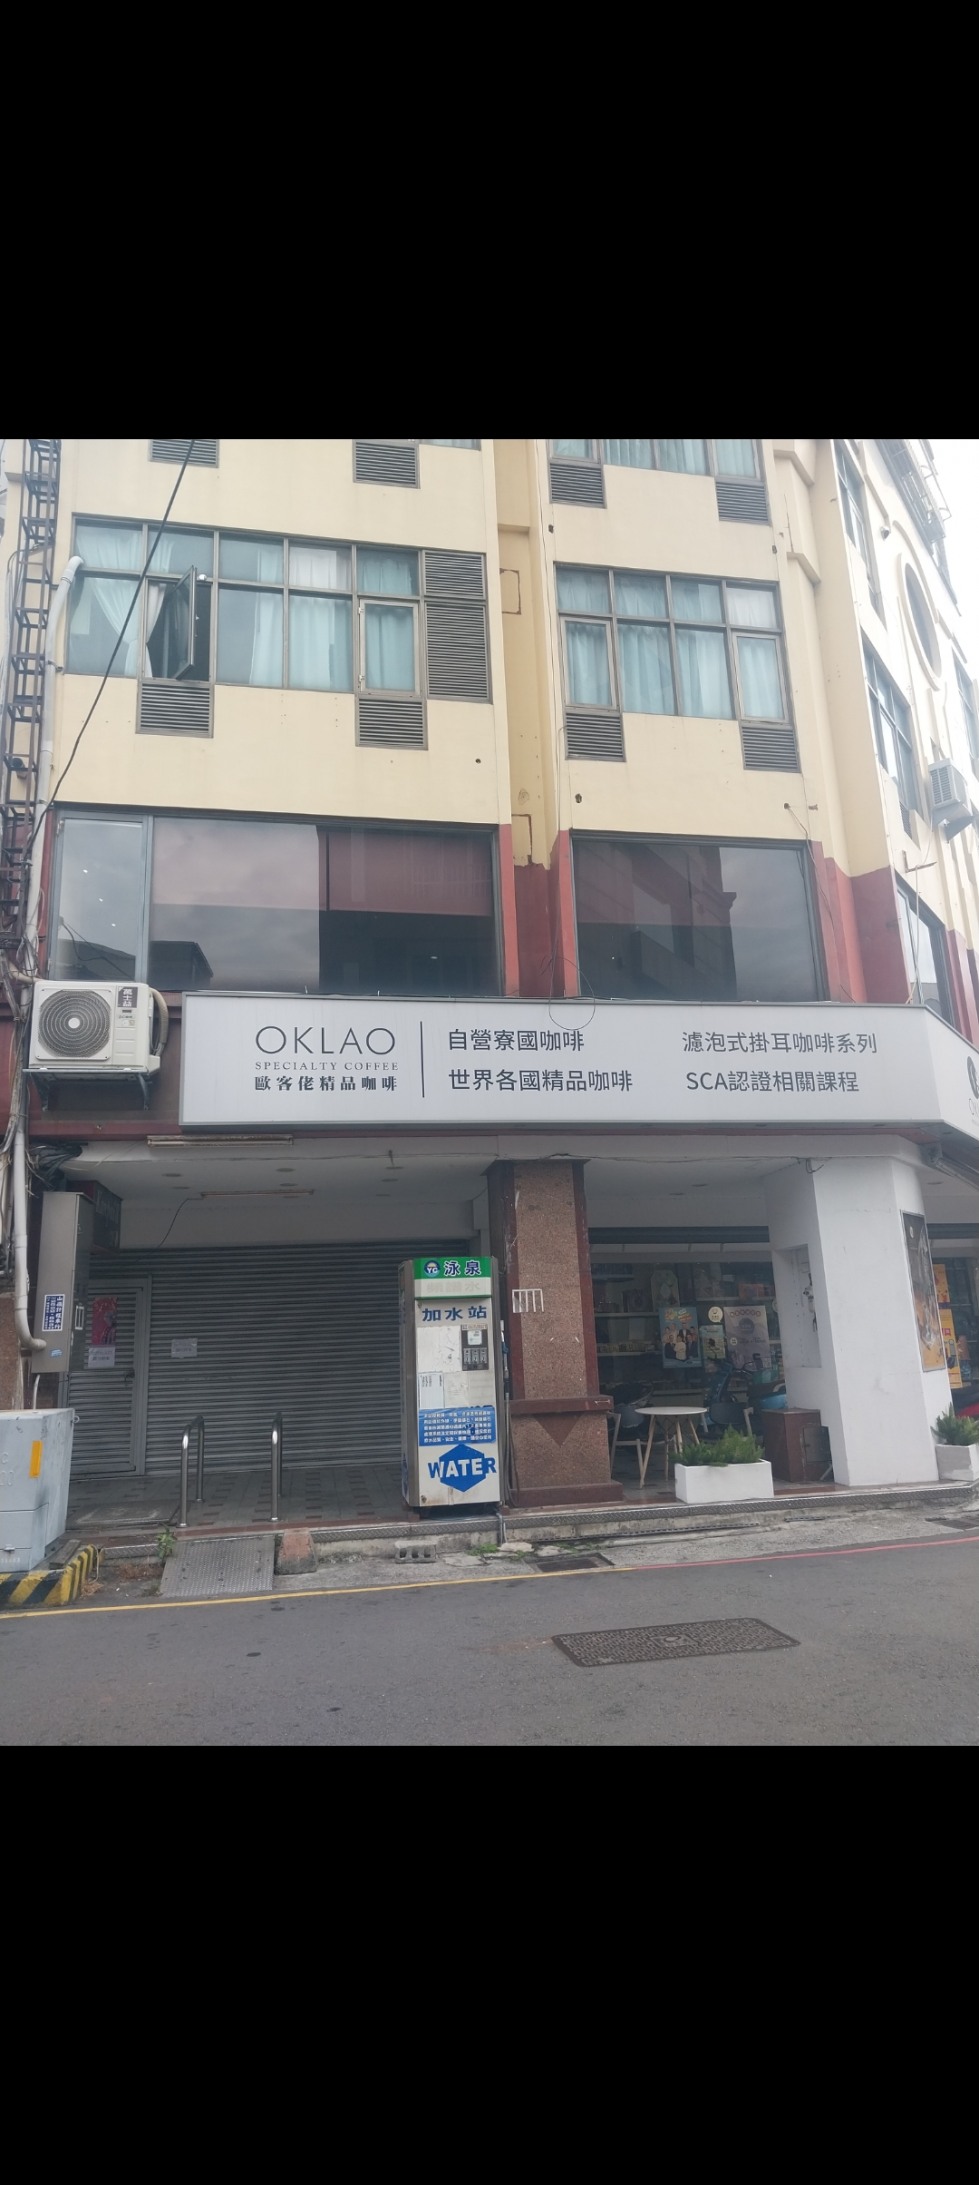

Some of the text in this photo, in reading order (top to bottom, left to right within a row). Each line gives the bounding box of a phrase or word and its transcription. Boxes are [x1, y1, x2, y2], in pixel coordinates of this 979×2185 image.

[255, 1025, 396, 1055] OKLAO
[449, 1028, 584, 1051] 自營寮國咖啡
[682, 1031, 878, 1054] 濾泡式掛耳咖啡系列
[255, 1061, 399, 1071] SPECIALTY COFFEE
[255, 1075, 398, 1091] 歐客佬精品咖啡
[449, 1068, 633, 1092] 世界各國精品咖啡
[686, 1070, 860, 1092] SCA認證相關課程
[443, 1259, 482, 1277] 泳泉
[422, 1305, 487, 1322] 加水站
[427, 1457, 497, 1479] WATER
